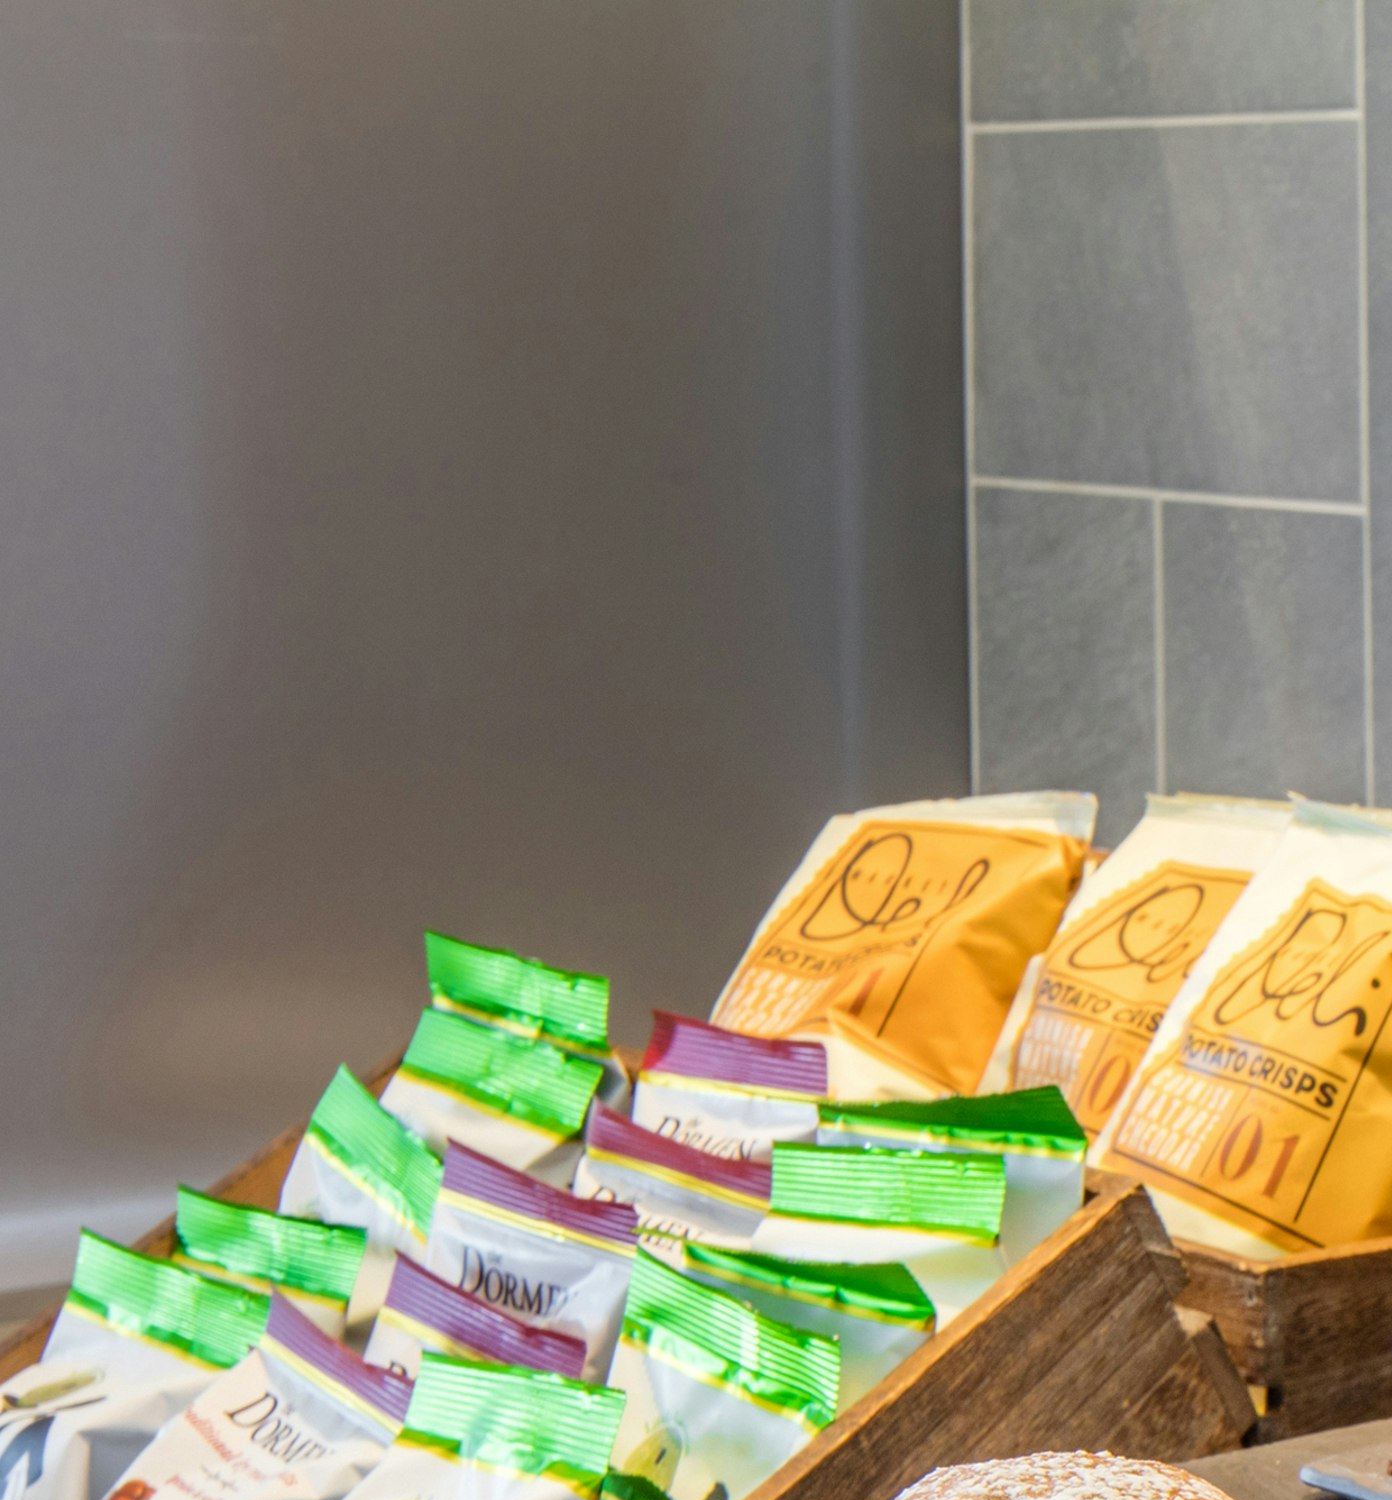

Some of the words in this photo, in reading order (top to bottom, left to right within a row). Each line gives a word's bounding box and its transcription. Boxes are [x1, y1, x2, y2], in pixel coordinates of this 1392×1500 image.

[1181, 1034, 1248, 1073] POTATO
[1248, 1053, 1339, 1110] CRISPS
[1218, 1112, 1301, 1200] 01
